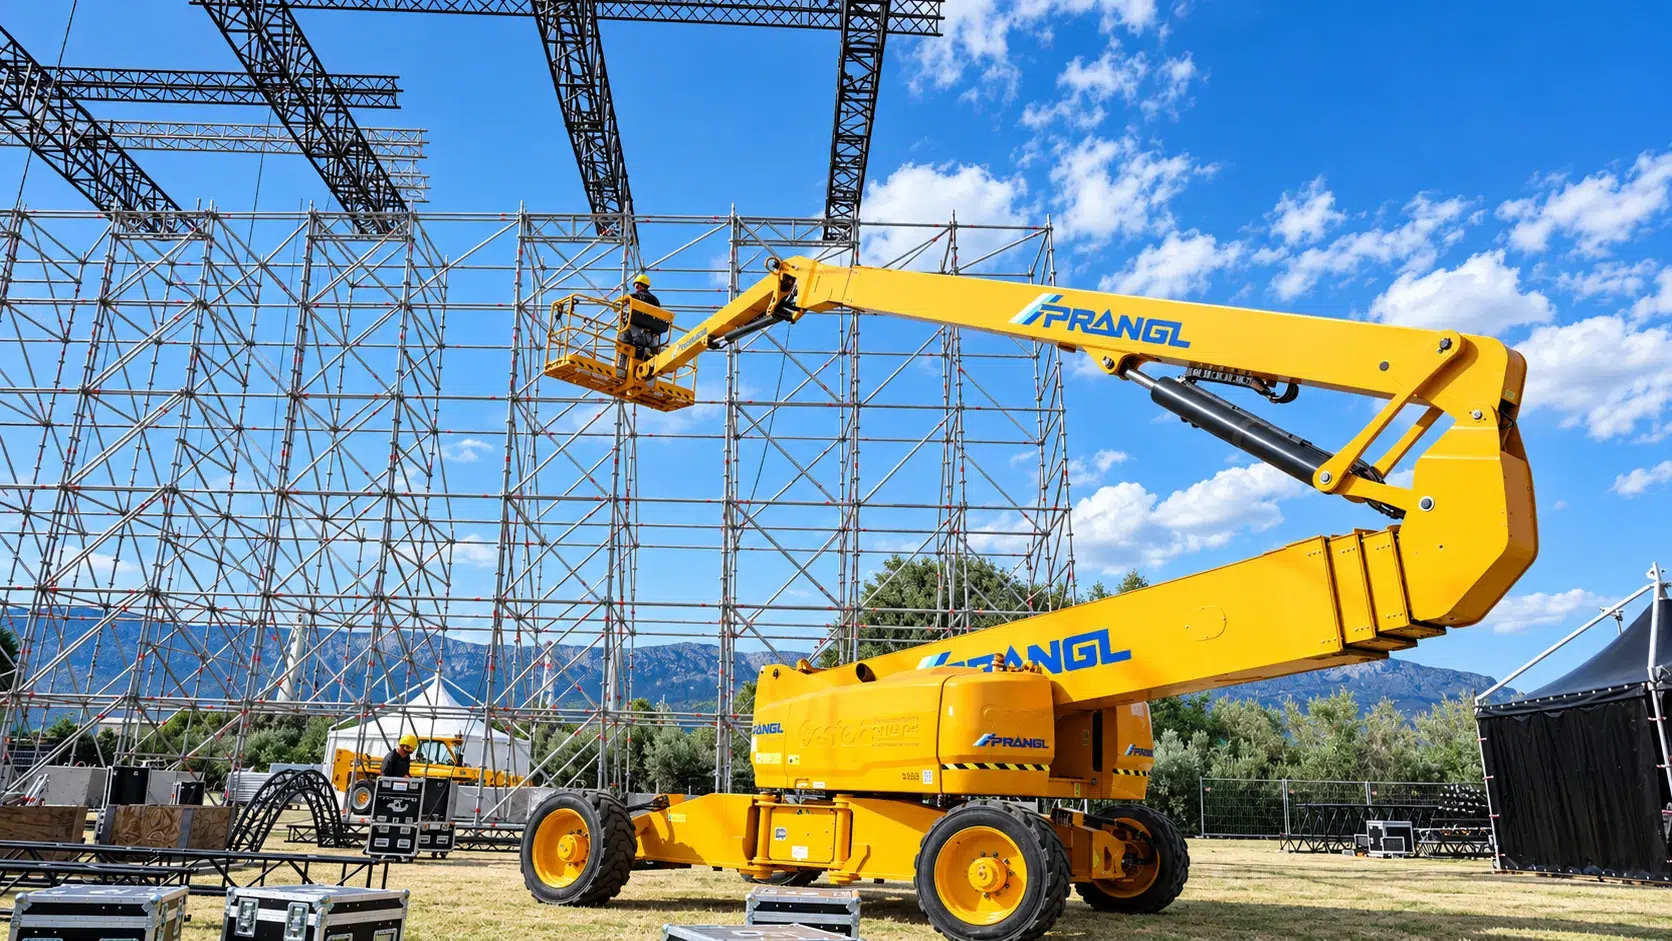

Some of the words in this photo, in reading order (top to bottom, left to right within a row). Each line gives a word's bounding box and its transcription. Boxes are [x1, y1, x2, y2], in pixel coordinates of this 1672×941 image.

[1040, 304, 1191, 348] PRANGL
[950, 629, 1131, 674] ANGL
[990, 734, 1049, 749] PRANGL
